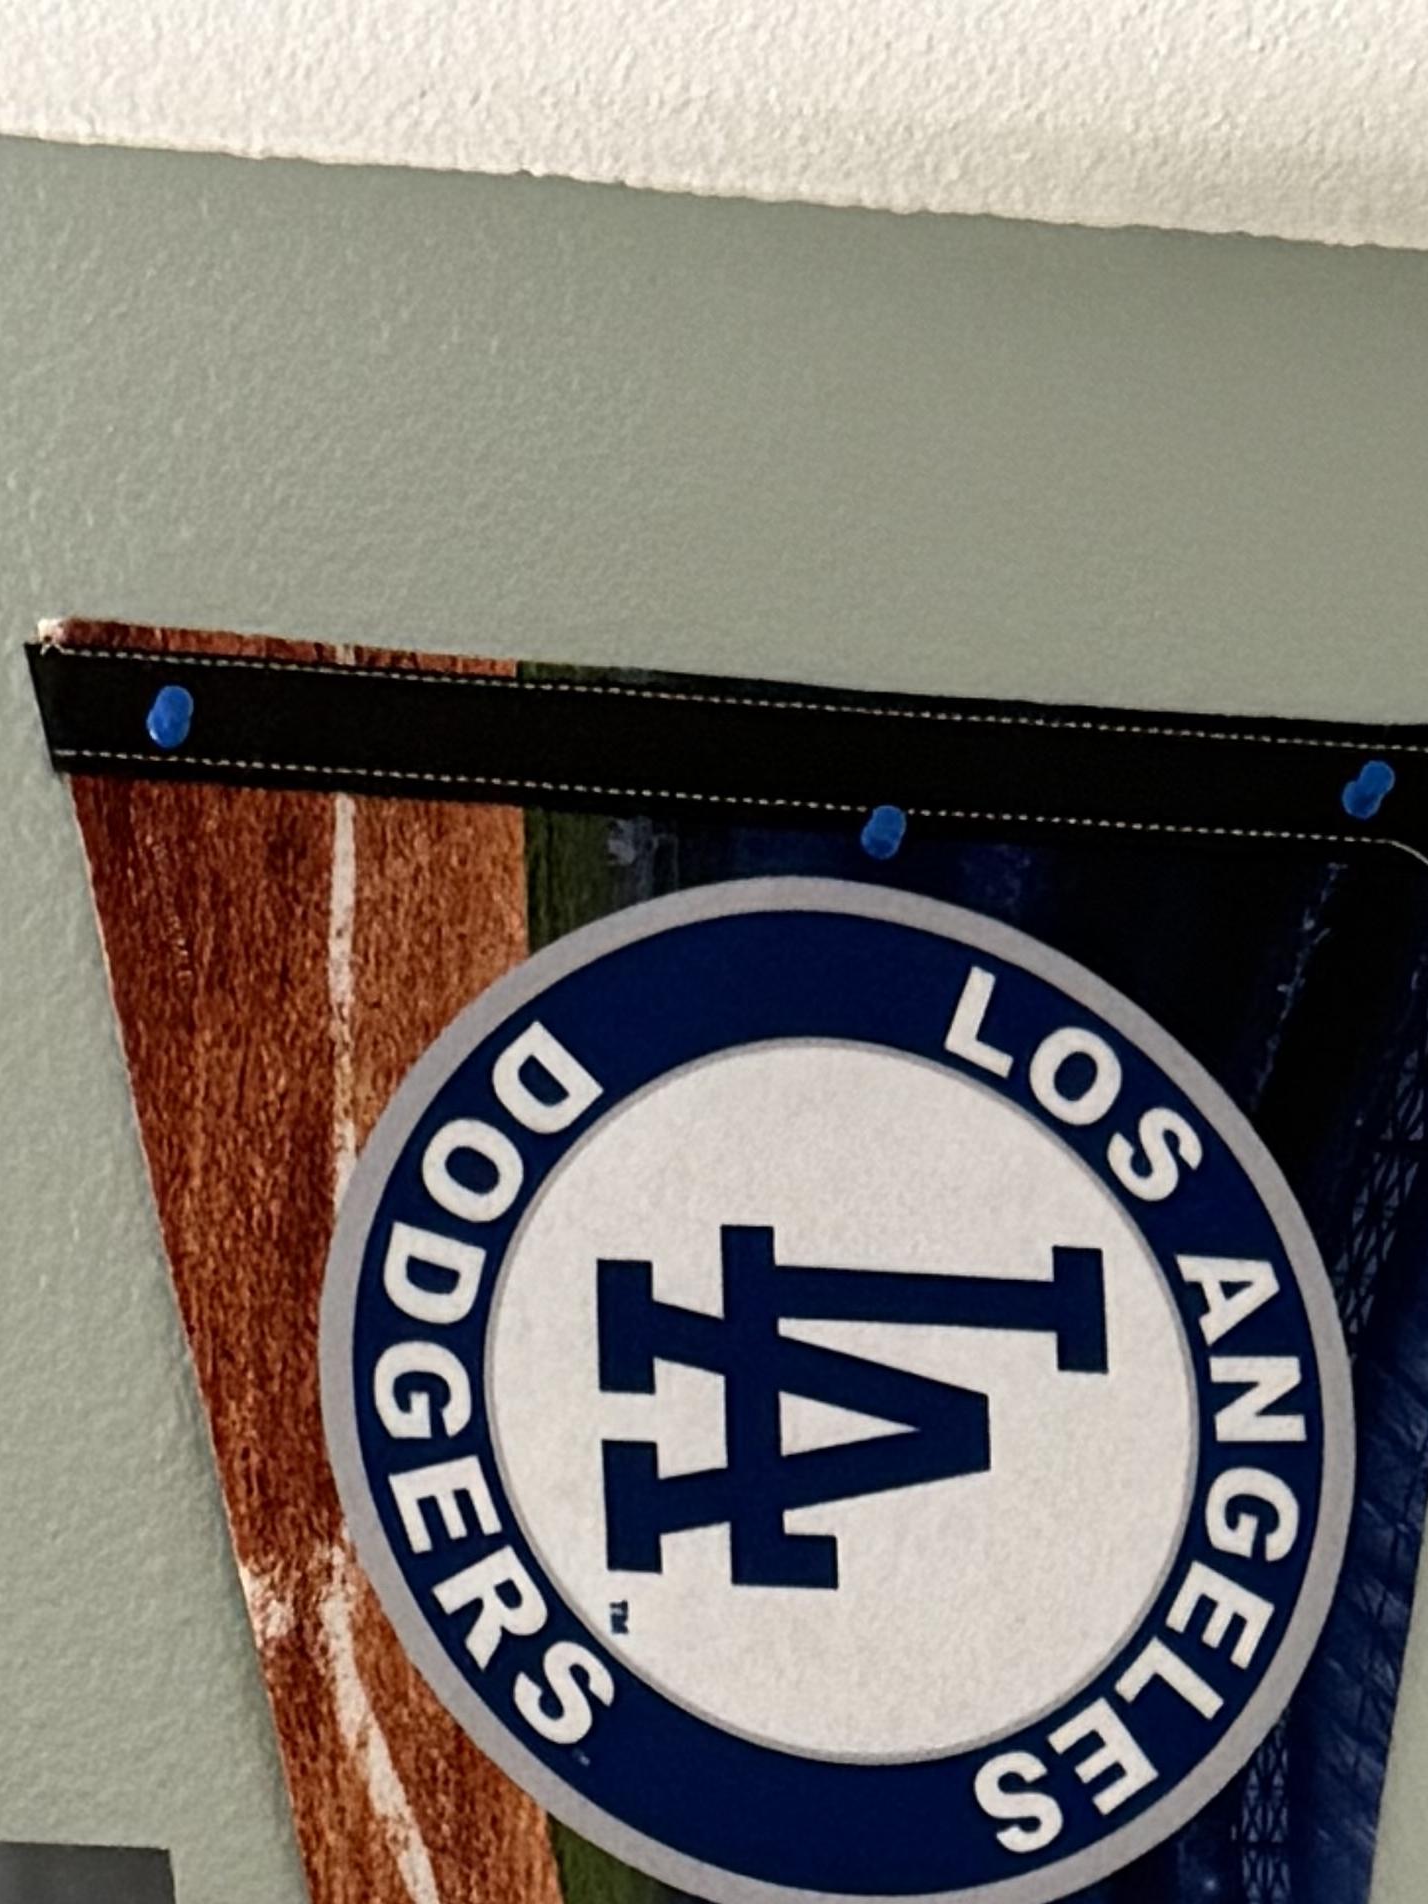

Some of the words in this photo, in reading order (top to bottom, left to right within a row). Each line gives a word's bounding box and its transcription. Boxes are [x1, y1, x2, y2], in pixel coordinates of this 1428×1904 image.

[944, 965, 1203, 1202] LOS
[373, 1020, 615, 1745] DODGERS
[595, 1224, 1109, 1590] LA
[973, 1254, 1308, 1853] ANGELES
